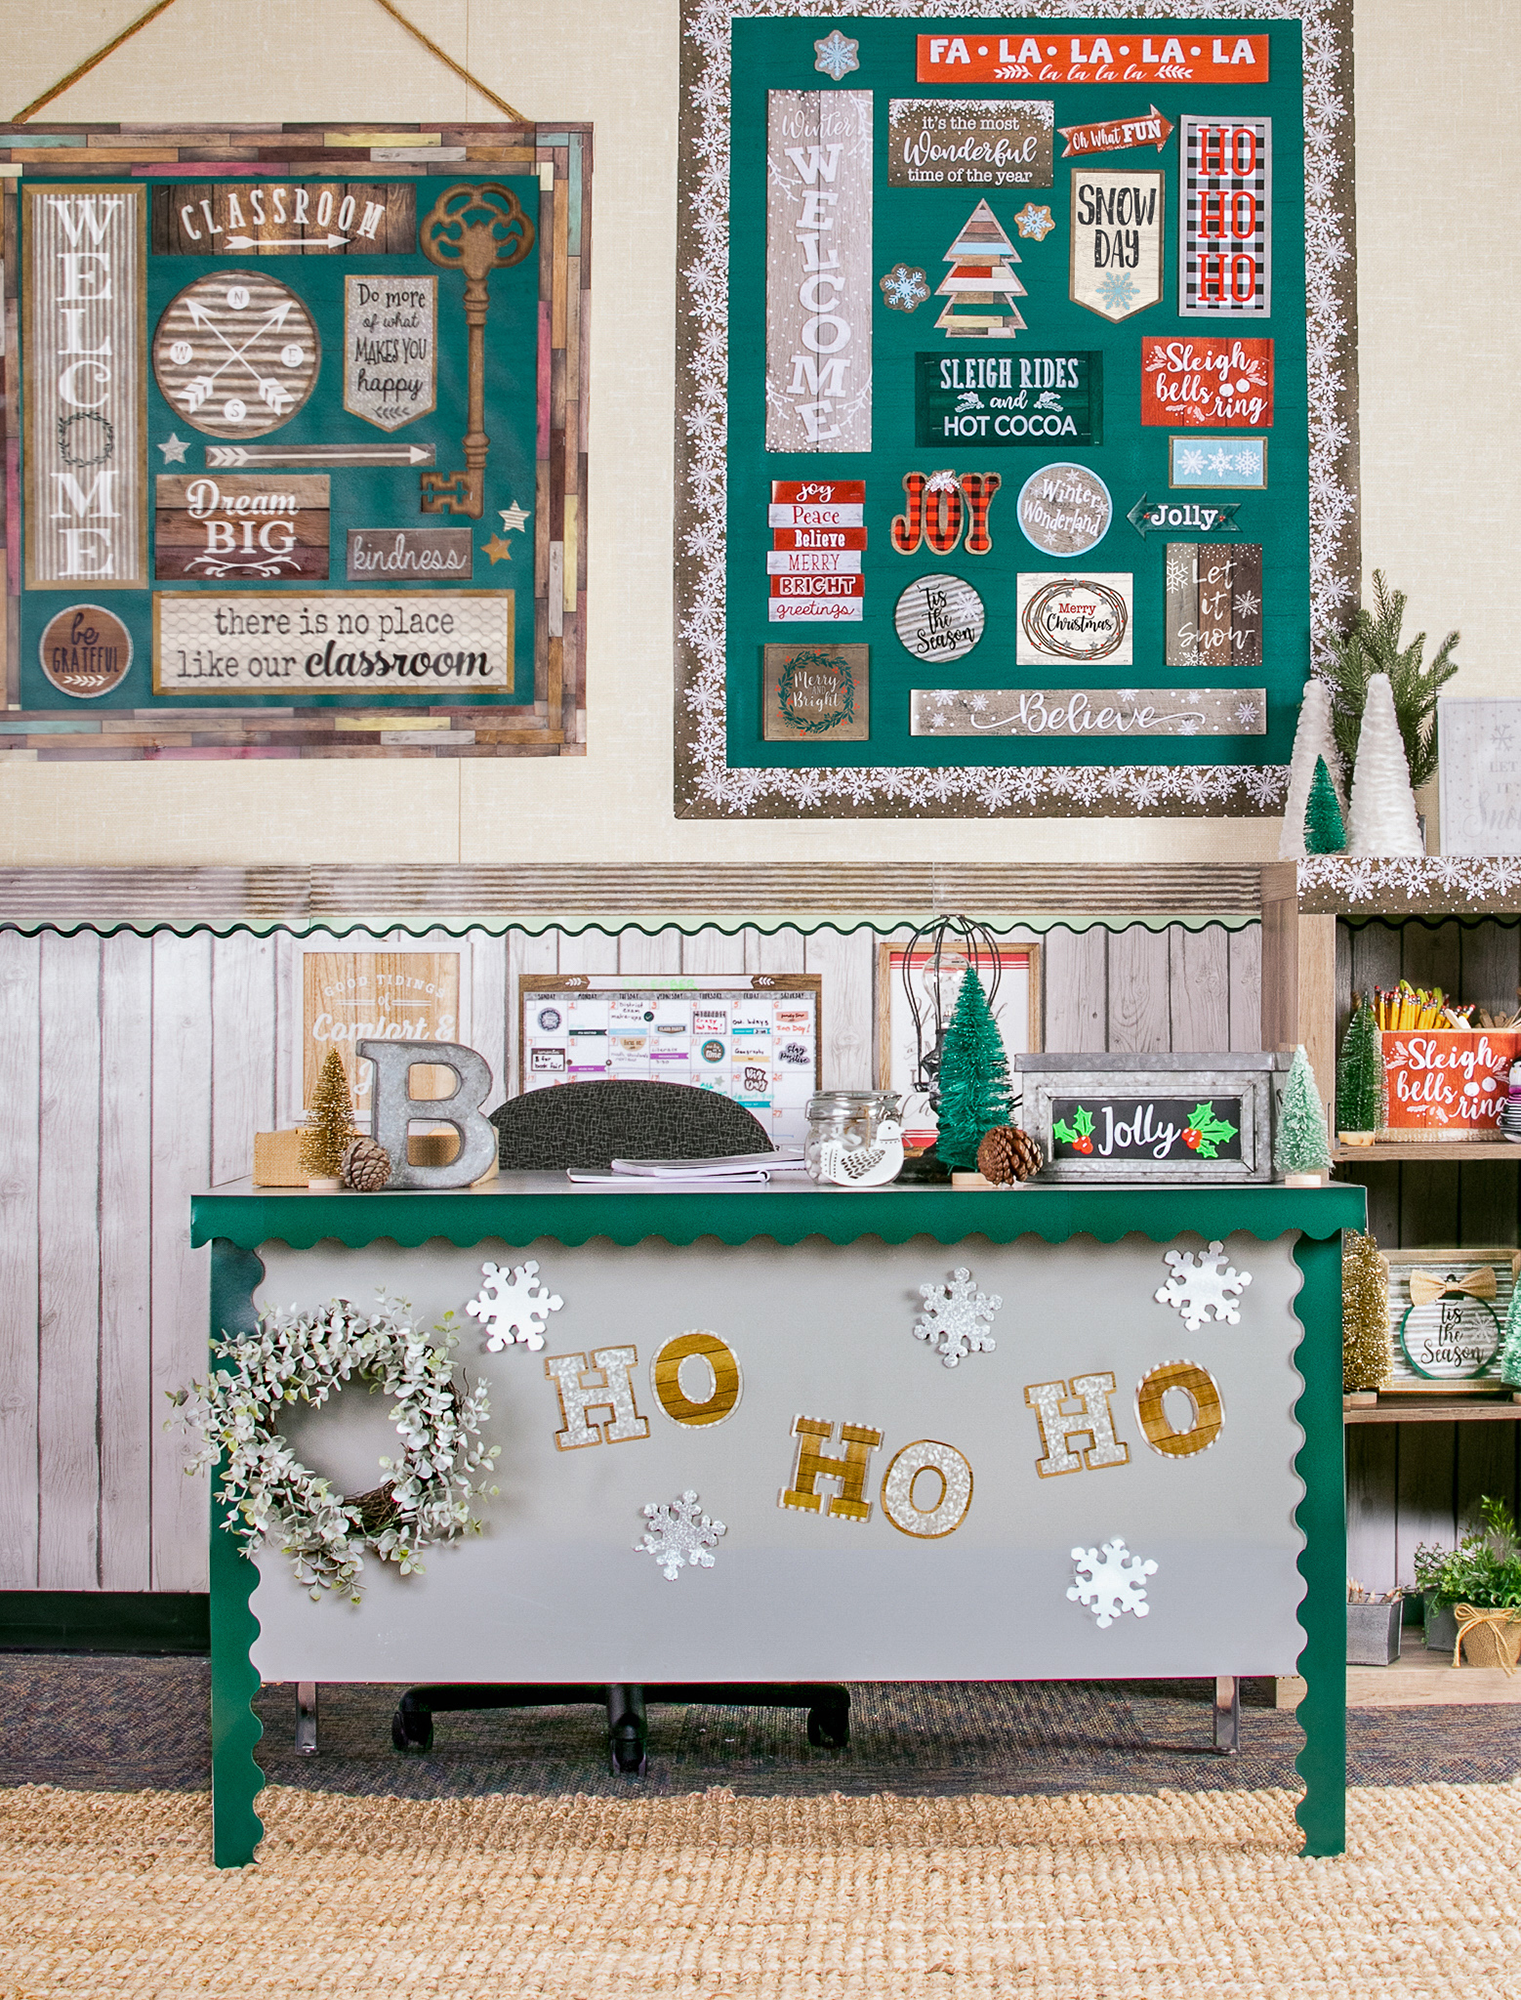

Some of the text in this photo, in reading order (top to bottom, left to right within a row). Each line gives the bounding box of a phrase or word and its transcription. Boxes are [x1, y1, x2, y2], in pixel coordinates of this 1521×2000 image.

[930, 38, 1255, 64] FA LA LA LA LA
[1038, 63, 1147, 80] la la la la
[782, 110, 857, 138] Winter
[922, 116, 1020, 130] it's the most
[1072, 119, 1162, 150] Oh What FUN
[903, 131, 1037, 167] Wonderful
[1197, 128, 1256, 176] HO
[908, 168, 1033, 186] time of the year
[181, 188, 385, 240] CLASSROOM
[1077, 184, 1157, 226] SNOW
[1197, 191, 1256, 239] HO
[1094, 229, 1139, 268] DAY
[1197, 254, 1256, 302] HO
[233, 293, 244, 303] N
[357, 284, 426, 308] Do more
[784, 143, 851, 443] WELCOME
[362, 312, 419, 332] of what
[175, 347, 189, 359] W
[288, 349, 298, 361] E
[354, 337, 427, 365] MAKES YOU
[1165, 342, 1251, 381] Sleigh
[357, 368, 423, 401] happy
[939, 358, 1079, 389] SLEIGH RIDES
[989, 390, 1028, 410] and
[1156, 373, 1213, 404] bells
[230, 404, 241, 417] S
[1204, 397, 1267, 424] ring
[944, 415, 1077, 437] HOT COCOA
[186, 479, 300, 518] Dream
[796, 483, 835, 502] joy
[1041, 478, 1101, 508] Winter
[792, 505, 840, 525] Peace
[890, 470, 1001, 555] JOY
[1023, 500, 1102, 538] Wonderland
[1150, 504, 1219, 531] Jolly
[203, 520, 297, 554] BIG
[794, 530, 846, 548] Believe
[353, 533, 467, 571] kindness
[788, 554, 840, 571] MERRY
[779, 576, 856, 595] BRIGHT
[1191, 559, 1238, 589] Let
[776, 601, 855, 619] greetings
[1058, 602, 1096, 615] Merry
[1201, 591, 1227, 621] it
[71, 613, 99, 645] be
[215, 607, 454, 642] there is no place
[921, 608, 952, 634] the
[1046, 613, 1114, 632] Christmas
[1177, 621, 1255, 650] Snow
[917, 627, 975, 654] Season
[53, 647, 120, 673] GRATEFUL
[177, 639, 493, 678] like our classroom
[794, 671, 840, 692] Merry
[812, 685, 827, 695] AND
[793, 691, 841, 712] Bright
[1012, 692, 1162, 734] Believe
[1490, 761, 1518, 772] LET
[1497, 783, 1511, 794] IT
[1463, 790, 1521, 838] Sno
[324, 974, 446, 999] GOOD TIDINGS
[378, 991, 391, 1012] of
[312, 1012, 430, 1042] Comfort
[1407, 1036, 1498, 1080] Sleigh
[1396, 1070, 1458, 1104] bells
[356, 1038, 496, 1190] B
[1098, 1103, 1182, 1159] Jolly
[1432, 1322, 1463, 1346] the
[1420, 1338, 1484, 1367] Season
[544, 1328, 744, 1452] HO
[1023, 1358, 1226, 1479] HO
[776, 1414, 974, 1540] HO
